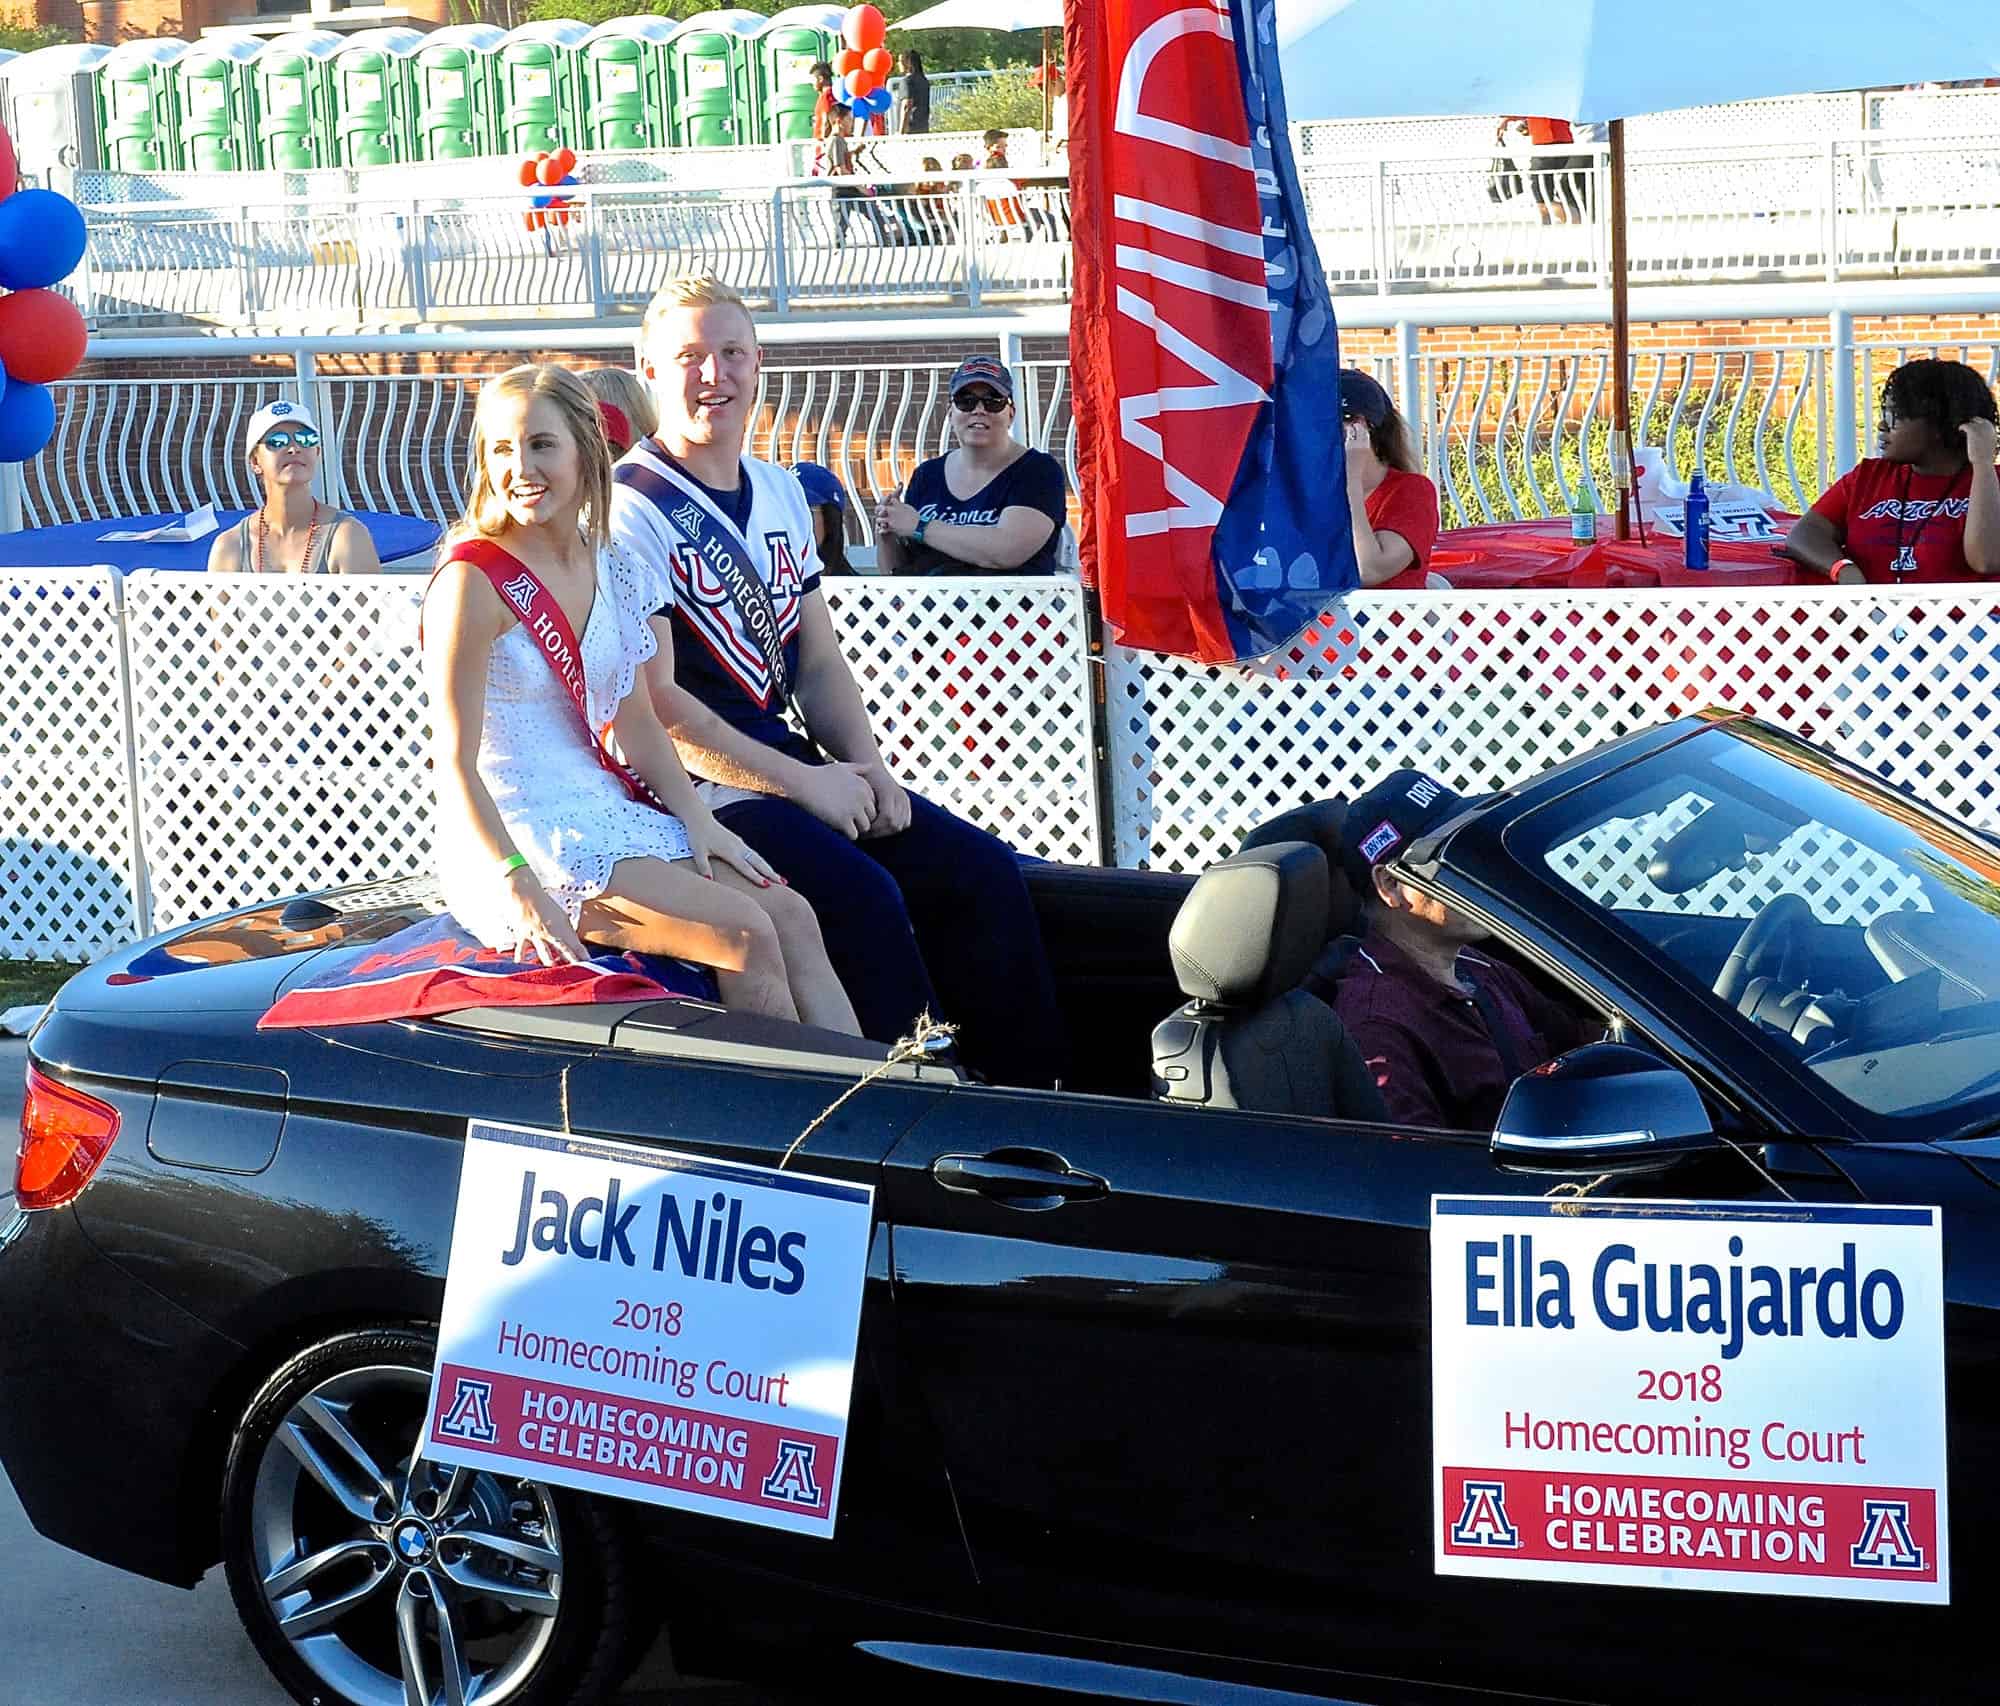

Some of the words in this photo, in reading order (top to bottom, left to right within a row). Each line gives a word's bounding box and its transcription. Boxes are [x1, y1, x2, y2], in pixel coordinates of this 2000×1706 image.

[673, 501, 705, 540] A
[502, 573, 540, 618] A
[765, 530, 803, 600] A
[703, 535, 785, 683] HOMECOMING
[502, 1171, 641, 1267] Jack
[652, 1191, 808, 1296] Niles
[612, 1300, 683, 1336] 2018
[1465, 1233, 1576, 1331] Ella
[1592, 1235, 1905, 1361] Guajardo
[497, 1321, 699, 1398] Homecoming
[705, 1360, 791, 1408] Court
[1637, 1364, 1723, 1402] 2018
[438, 1377, 497, 1443] A
[522, 1390, 749, 1458] HOMECOMING
[1505, 1411, 1751, 1470] Homecoming
[1761, 1421, 1867, 1465] Court
[517, 1421, 746, 1491] CELEBRATION
[761, 1438, 823, 1508] A
[1451, 1480, 1518, 1549] A
[1544, 1483, 1826, 1528] HOMECOMING
[1850, 1499, 1925, 1571] A
[1545, 1519, 1826, 1563] CELEBRATION
